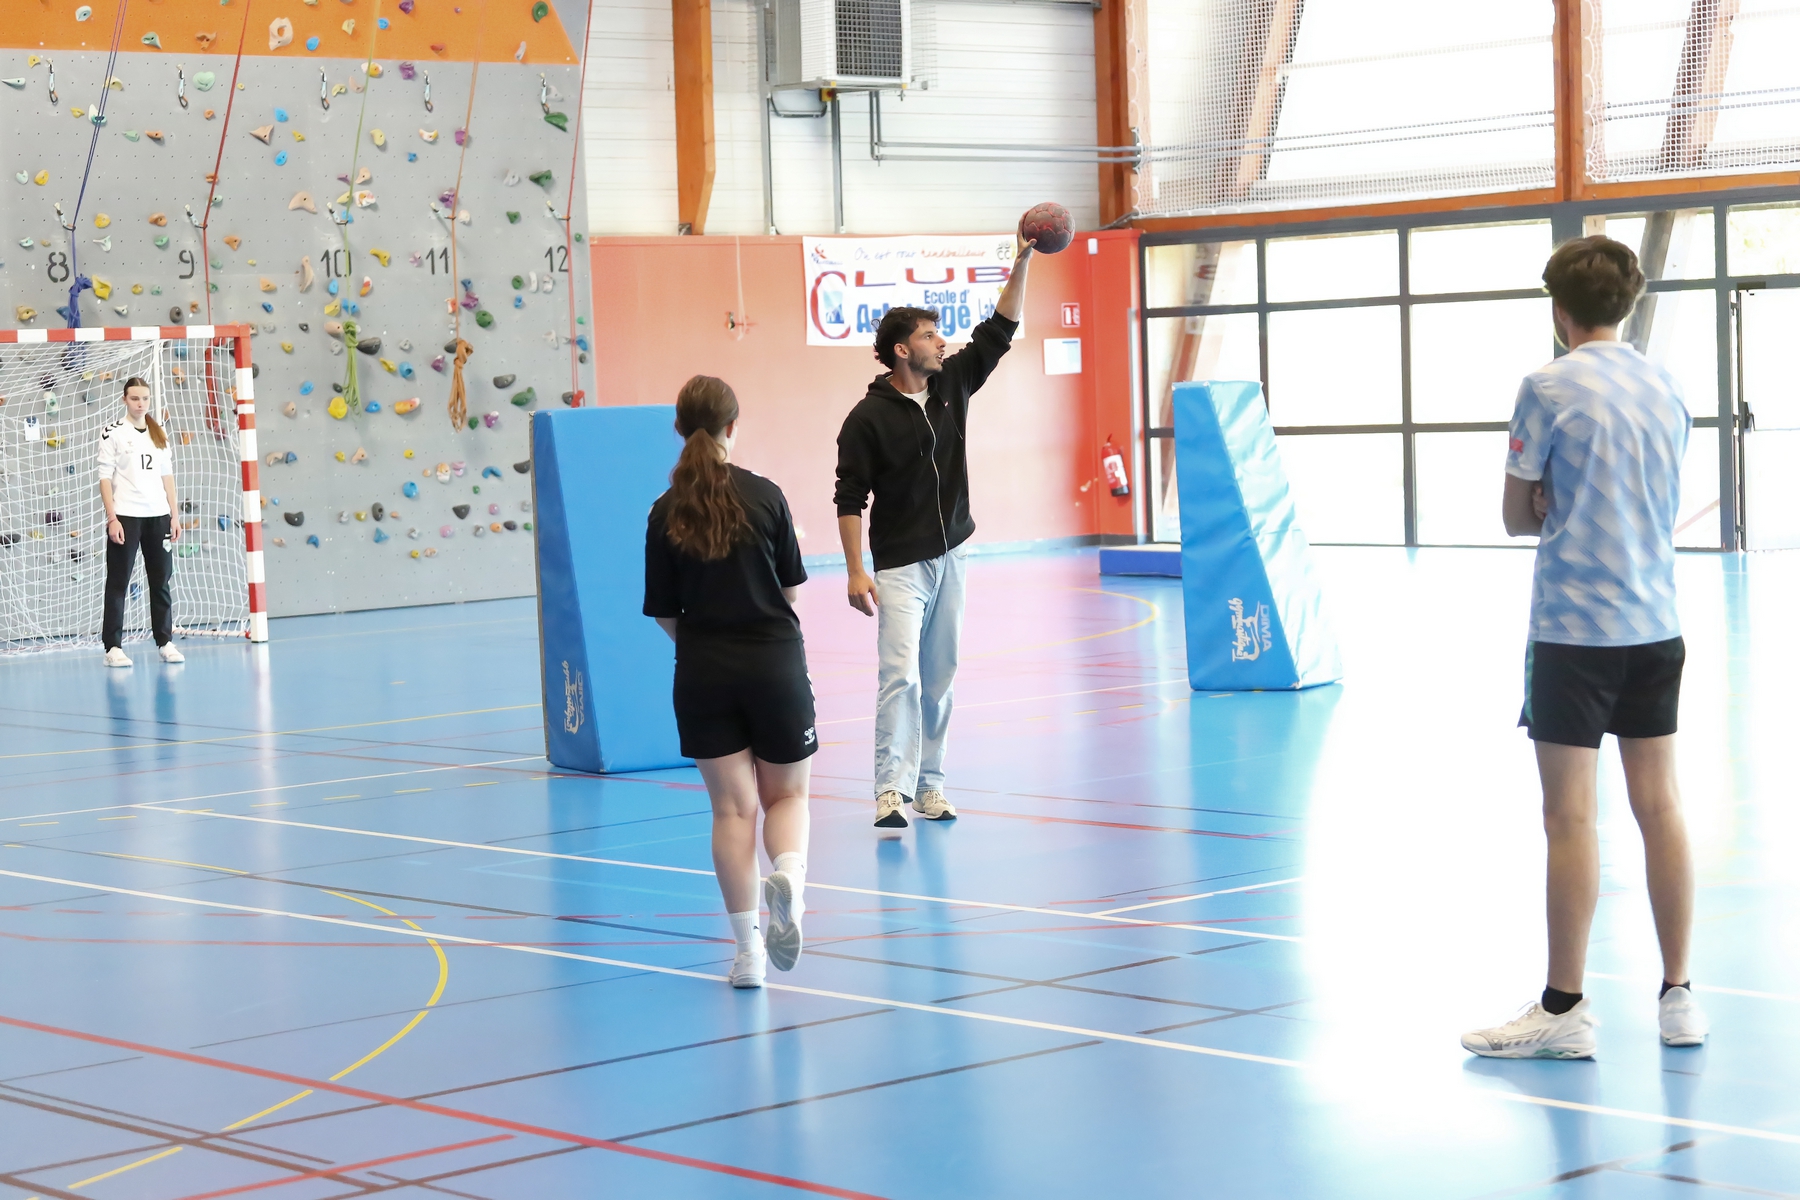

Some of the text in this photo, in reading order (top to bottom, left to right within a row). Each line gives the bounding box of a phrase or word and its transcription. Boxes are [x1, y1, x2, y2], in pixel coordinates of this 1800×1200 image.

[47, 251, 70, 283] 8
[178, 249, 195, 279] 9
[320, 249, 352, 278] 10
[425, 247, 449, 275] 11
[544, 245, 569, 273] 12
[924, 290, 956, 304] Ecole
[141, 454, 153, 470] 12
